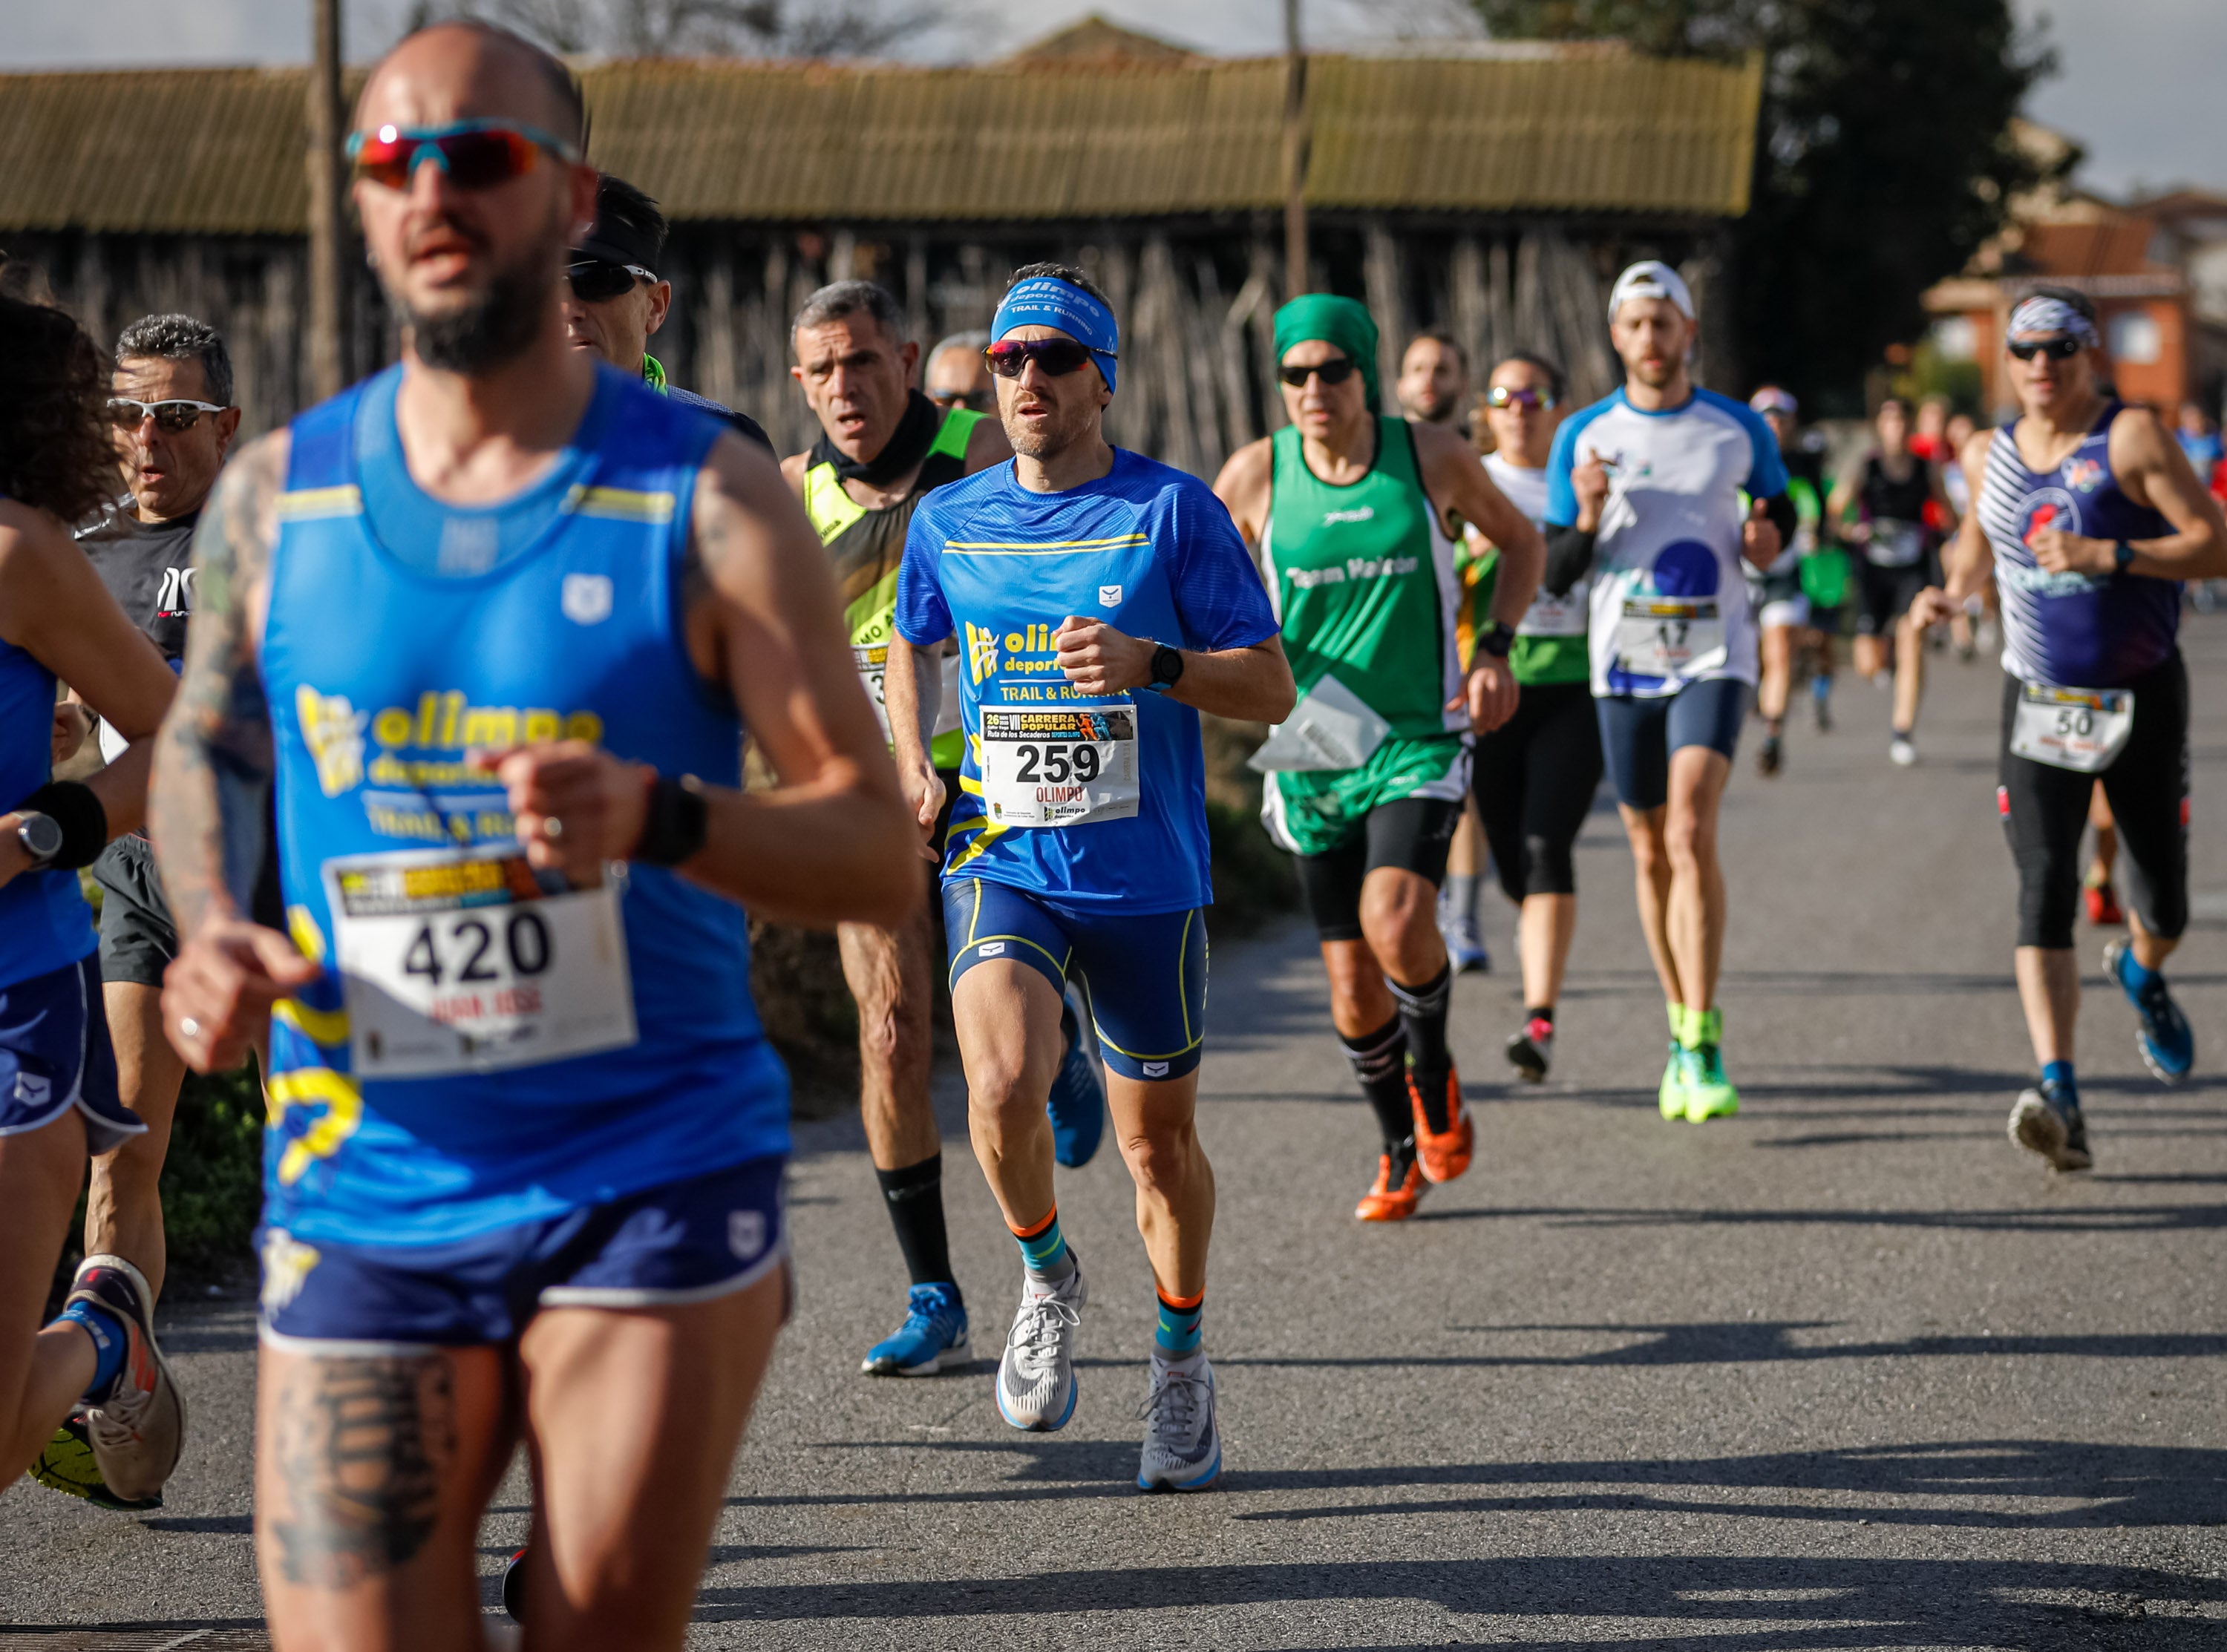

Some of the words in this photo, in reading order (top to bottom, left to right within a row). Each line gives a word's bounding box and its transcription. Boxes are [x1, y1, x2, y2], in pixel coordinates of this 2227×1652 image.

[1017, 282, 1099, 318] olimpo
[1011, 304, 1040, 313] TRAIL
[1054, 307, 1093, 335] RUNNING
[1004, 623, 1059, 653] oli
[1000, 686, 1044, 701] TRAIL
[1046, 686, 1057, 700] &
[373, 690, 604, 750] olimpo
[987, 714, 999, 725] 26
[1009, 714, 1021, 730] VII
[1021, 714, 1076, 723] CARRERA
[2056, 709, 2093, 736] 50
[1016, 744, 1100, 783] 259
[1036, 787, 1083, 803] OLIMPO
[1055, 806, 1086, 814] olimpo
[403, 911, 552, 986] 420
